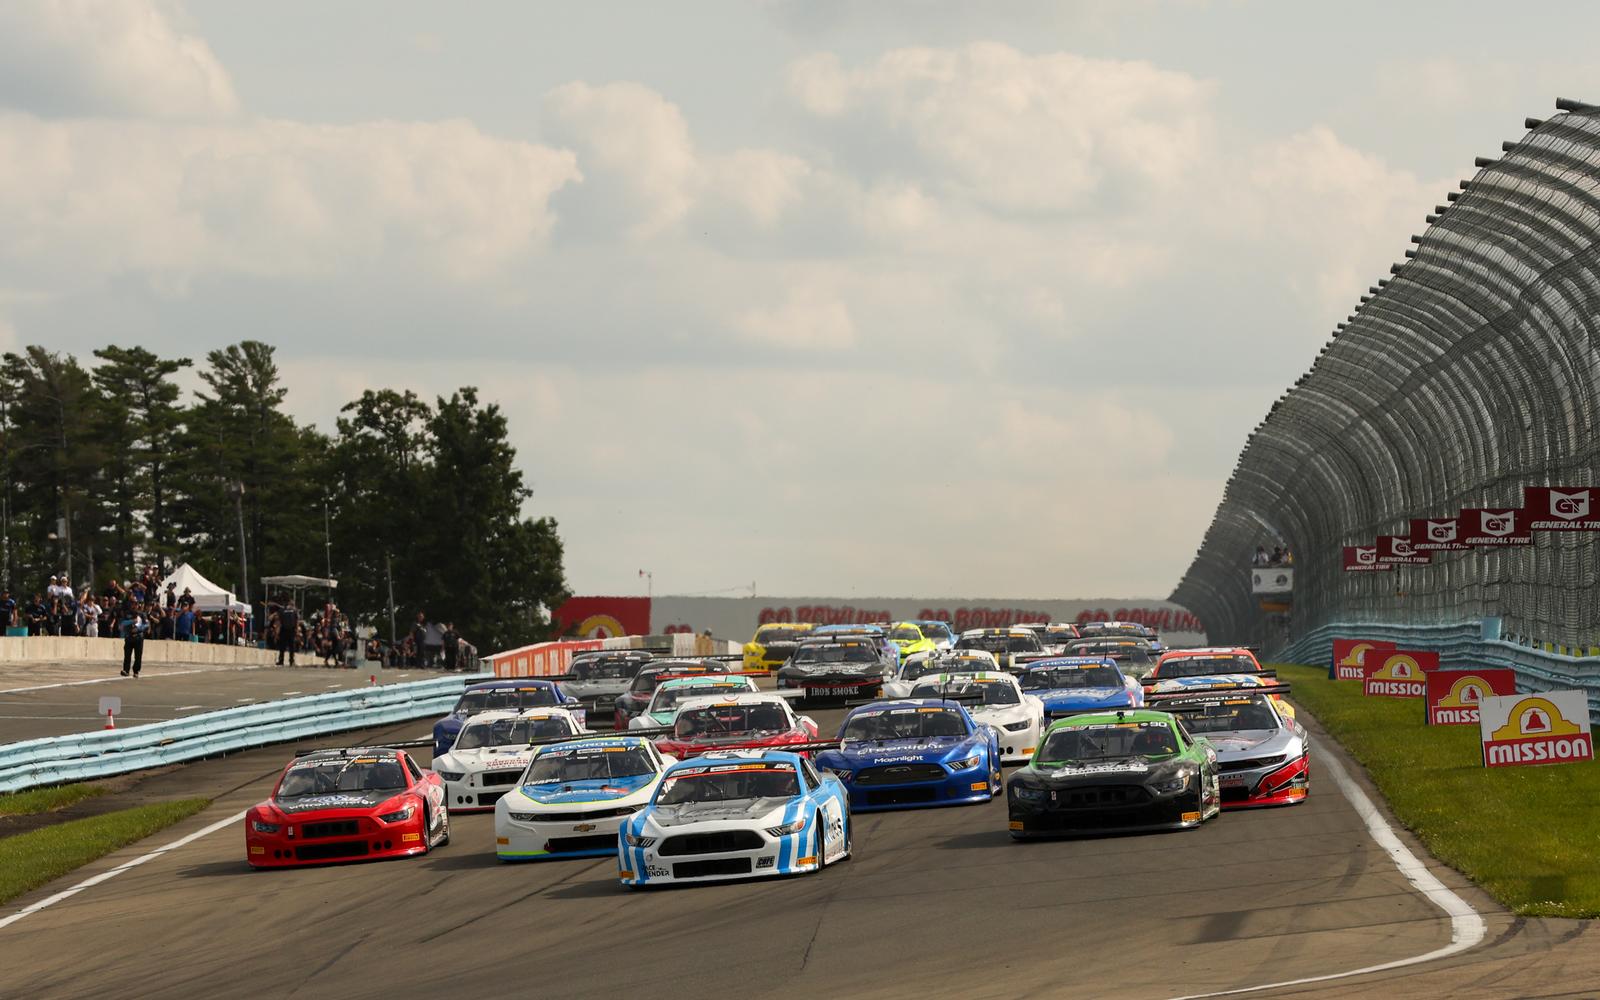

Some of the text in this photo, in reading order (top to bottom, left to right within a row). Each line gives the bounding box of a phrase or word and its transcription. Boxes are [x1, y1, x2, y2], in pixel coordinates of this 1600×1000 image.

[1530, 521, 1600, 529] GENERAL TIR
[1465, 536, 1531, 545] GENERAL TIRE
[1414, 542, 1453, 550] GENERAL
[811, 686, 860, 696] IRON SMOKE
[550, 741, 628, 752] CHEVROLET
[874, 754, 924, 764] Moonlight
